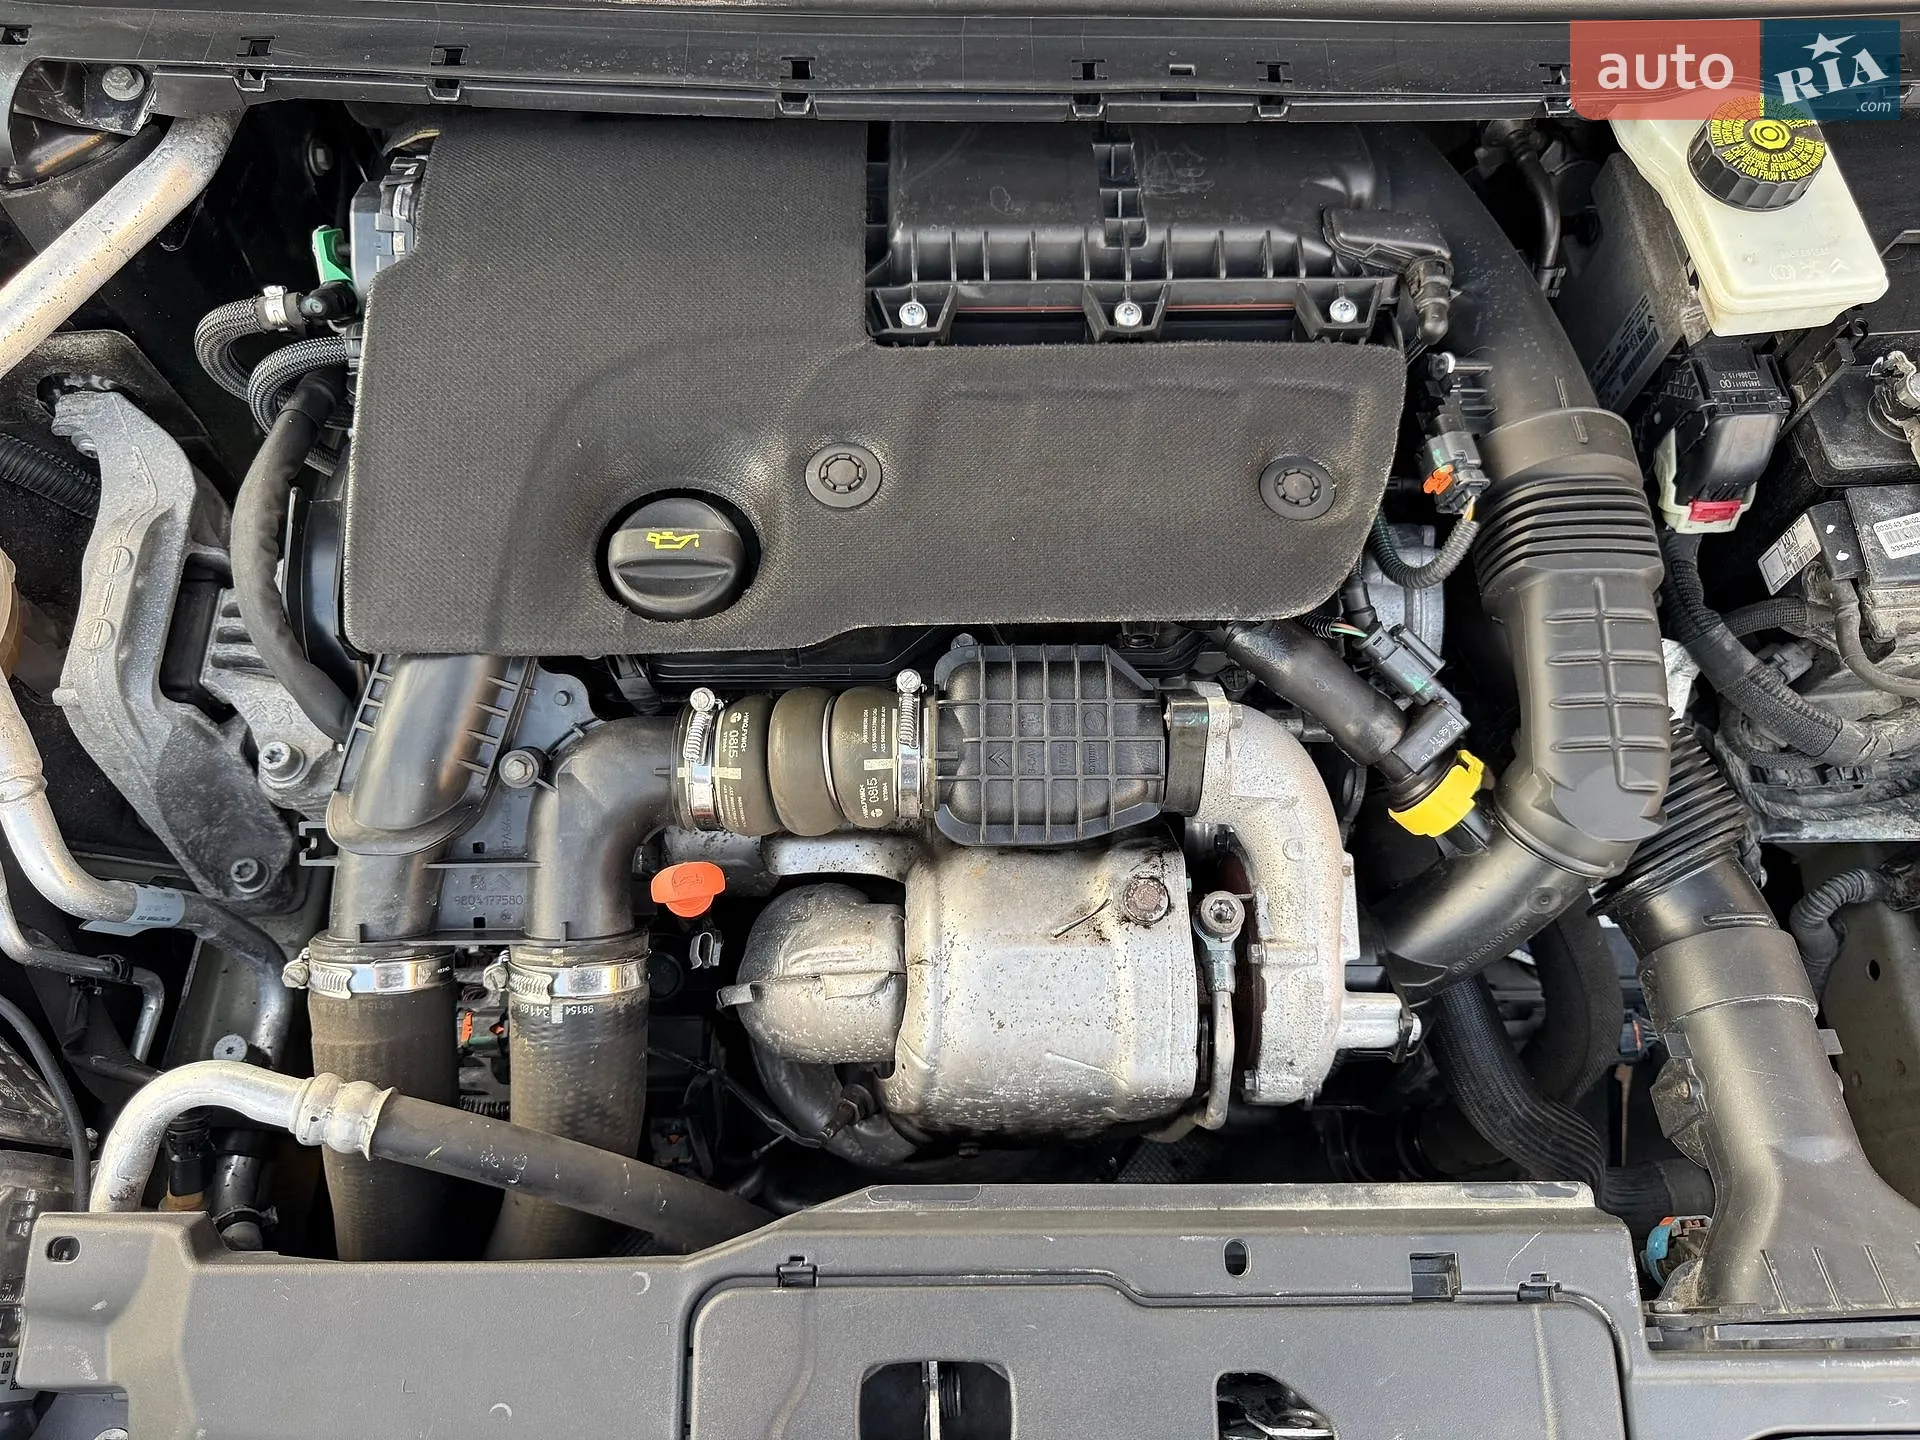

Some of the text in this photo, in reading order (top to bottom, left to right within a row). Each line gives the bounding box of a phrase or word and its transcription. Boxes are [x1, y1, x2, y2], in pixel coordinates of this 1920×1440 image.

[728, 729, 740, 759] 0815
[866, 777, 880, 803] 0815
[565, 1004, 595, 1016] 98154
